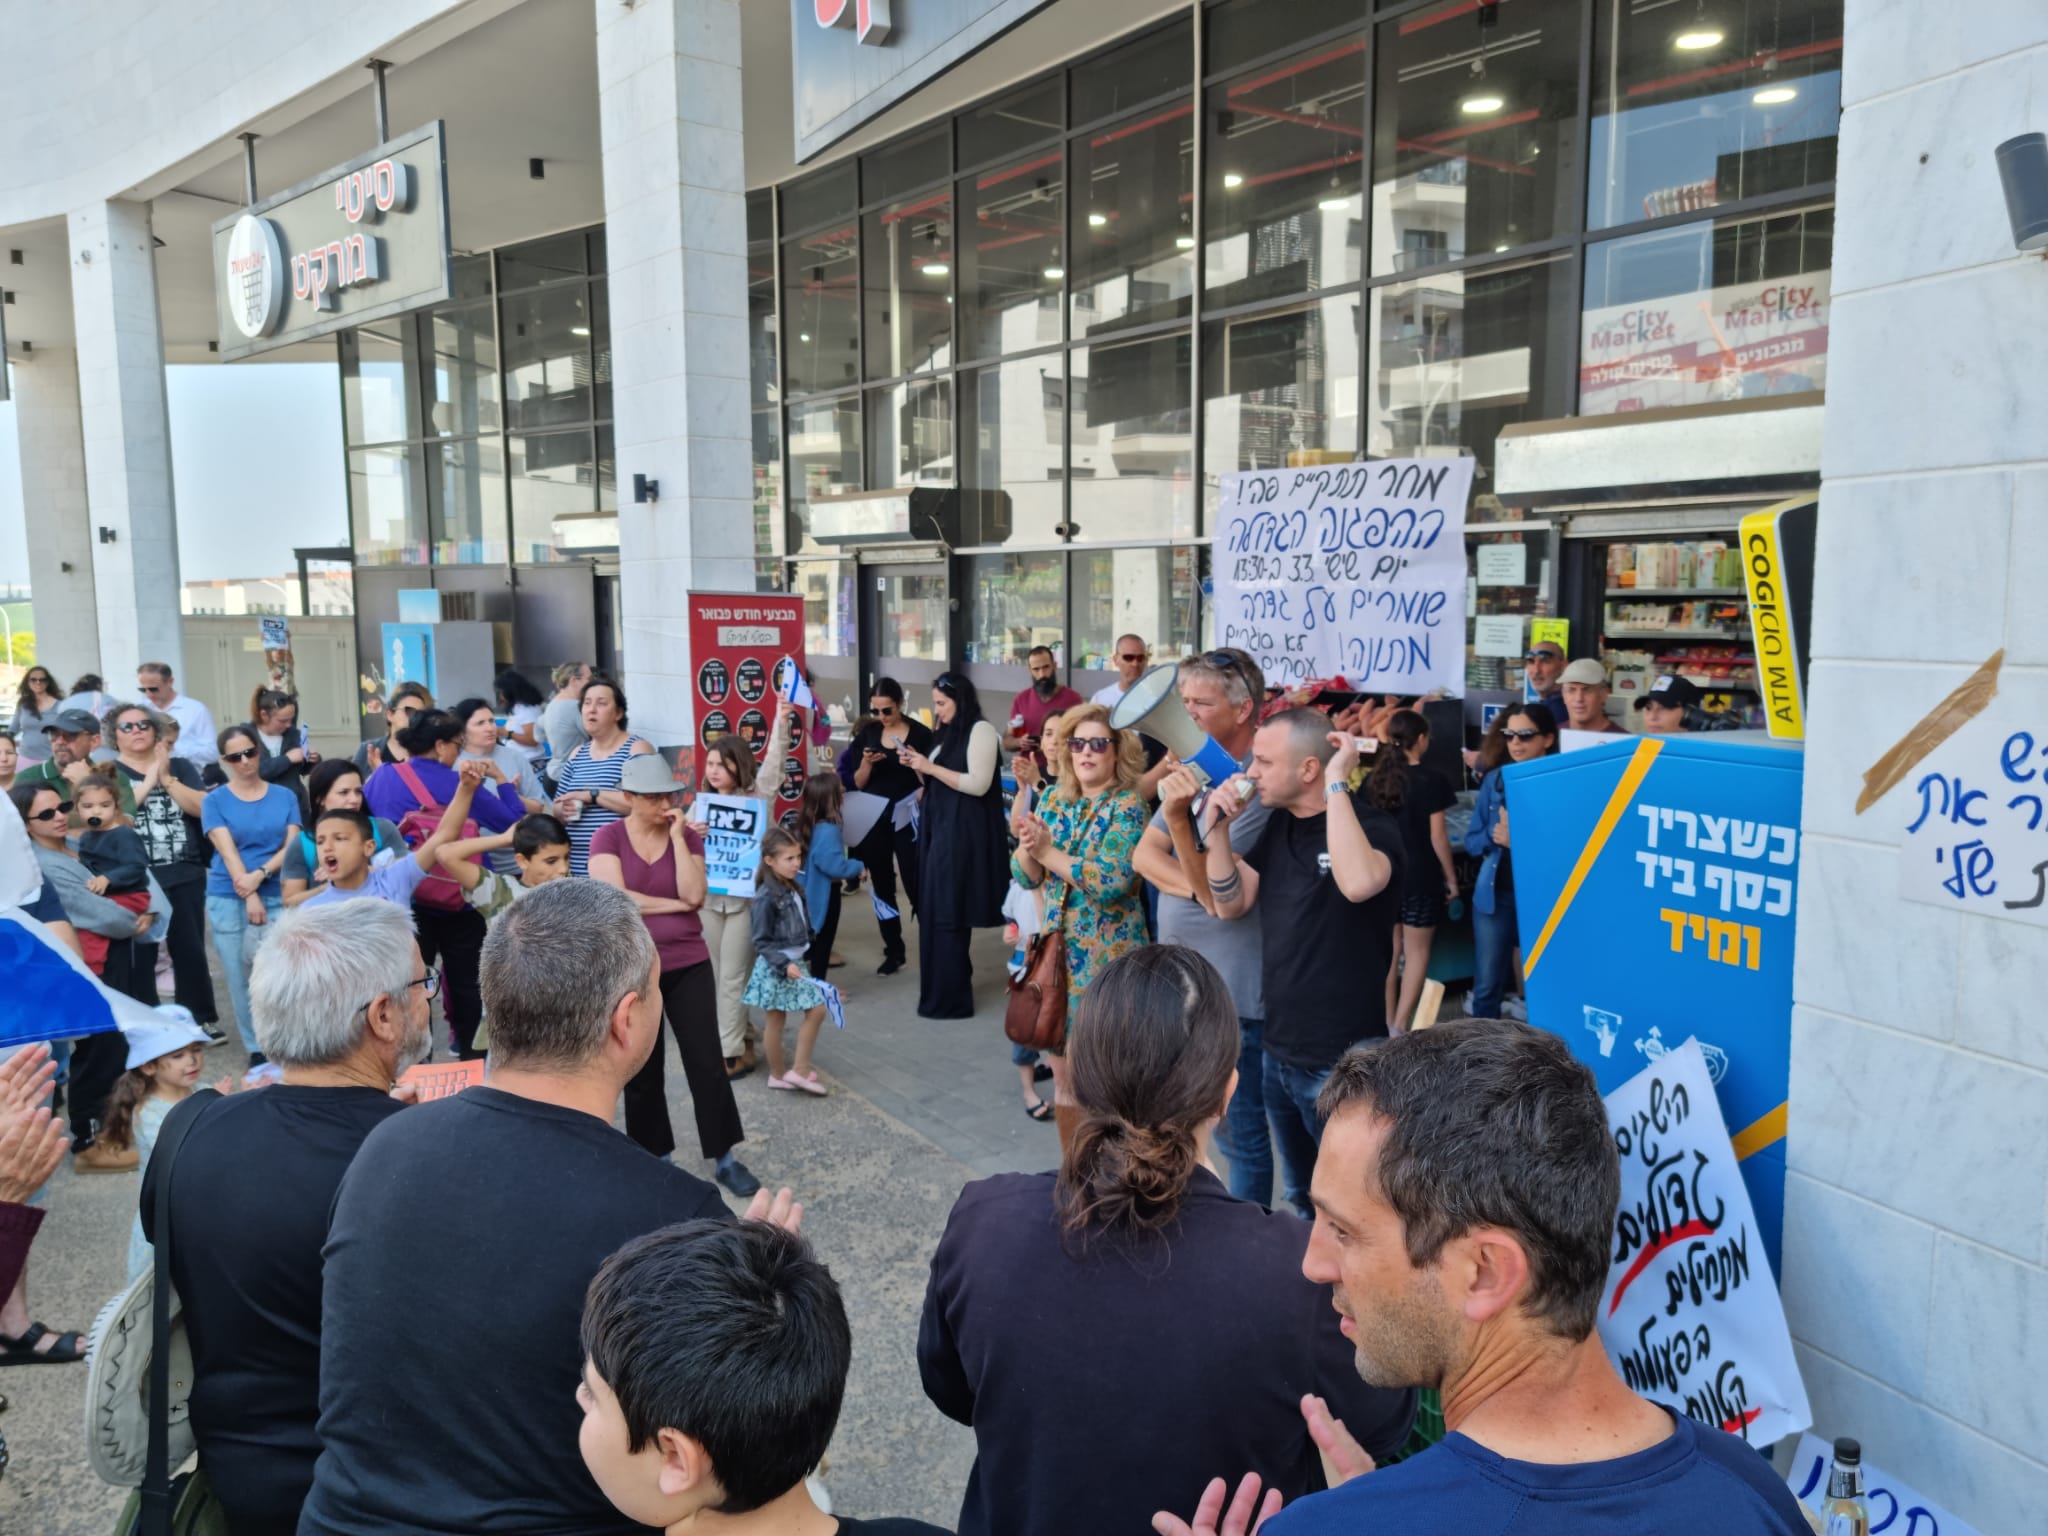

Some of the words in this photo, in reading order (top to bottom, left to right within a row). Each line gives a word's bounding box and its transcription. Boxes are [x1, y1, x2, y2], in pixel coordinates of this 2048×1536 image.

[336, 158, 396, 224] סיטי
[290, 232, 368, 313] מרקט
[1724, 300, 1821, 331] Market
[1761, 286, 1815, 310] City
[1591, 322, 1676, 350] Market
[1621, 309, 1670, 331] City
[1236, 475, 1279, 506] פה!
[1378, 464, 1449, 502] מחר
[1228, 509, 1307, 553] הגדולה
[1319, 506, 1445, 553] ההפגנה
[1324, 550, 1361, 581] שישי
[1370, 555, 1408, 584] יום
[733, 609, 761, 620] חודש
[763, 609, 796, 622] מבצעי
[1241, 589, 1292, 622] גדרה
[1303, 585, 1336, 631] על
[1349, 588, 1446, 628] שומרים
[1225, 624, 1274, 652] סוגרים
[1285, 633, 1308, 652] לא
[1261, 655, 1317, 685] עסקים
[1338, 632, 1431, 683] מתונה!
[1768, 666, 1794, 724] ATM
[709, 809, 753, 831] לא!
[1905, 773, 1988, 834] את
[1638, 803, 1797, 866] כשצריך
[716, 847, 740, 863] של
[1636, 850, 1697, 897] ביד
[1936, 838, 1997, 899] שלי
[1704, 864, 1793, 917] כסף
[1660, 907, 1762, 972] ומיד
[1615, 1148, 1725, 1265] גדולים
